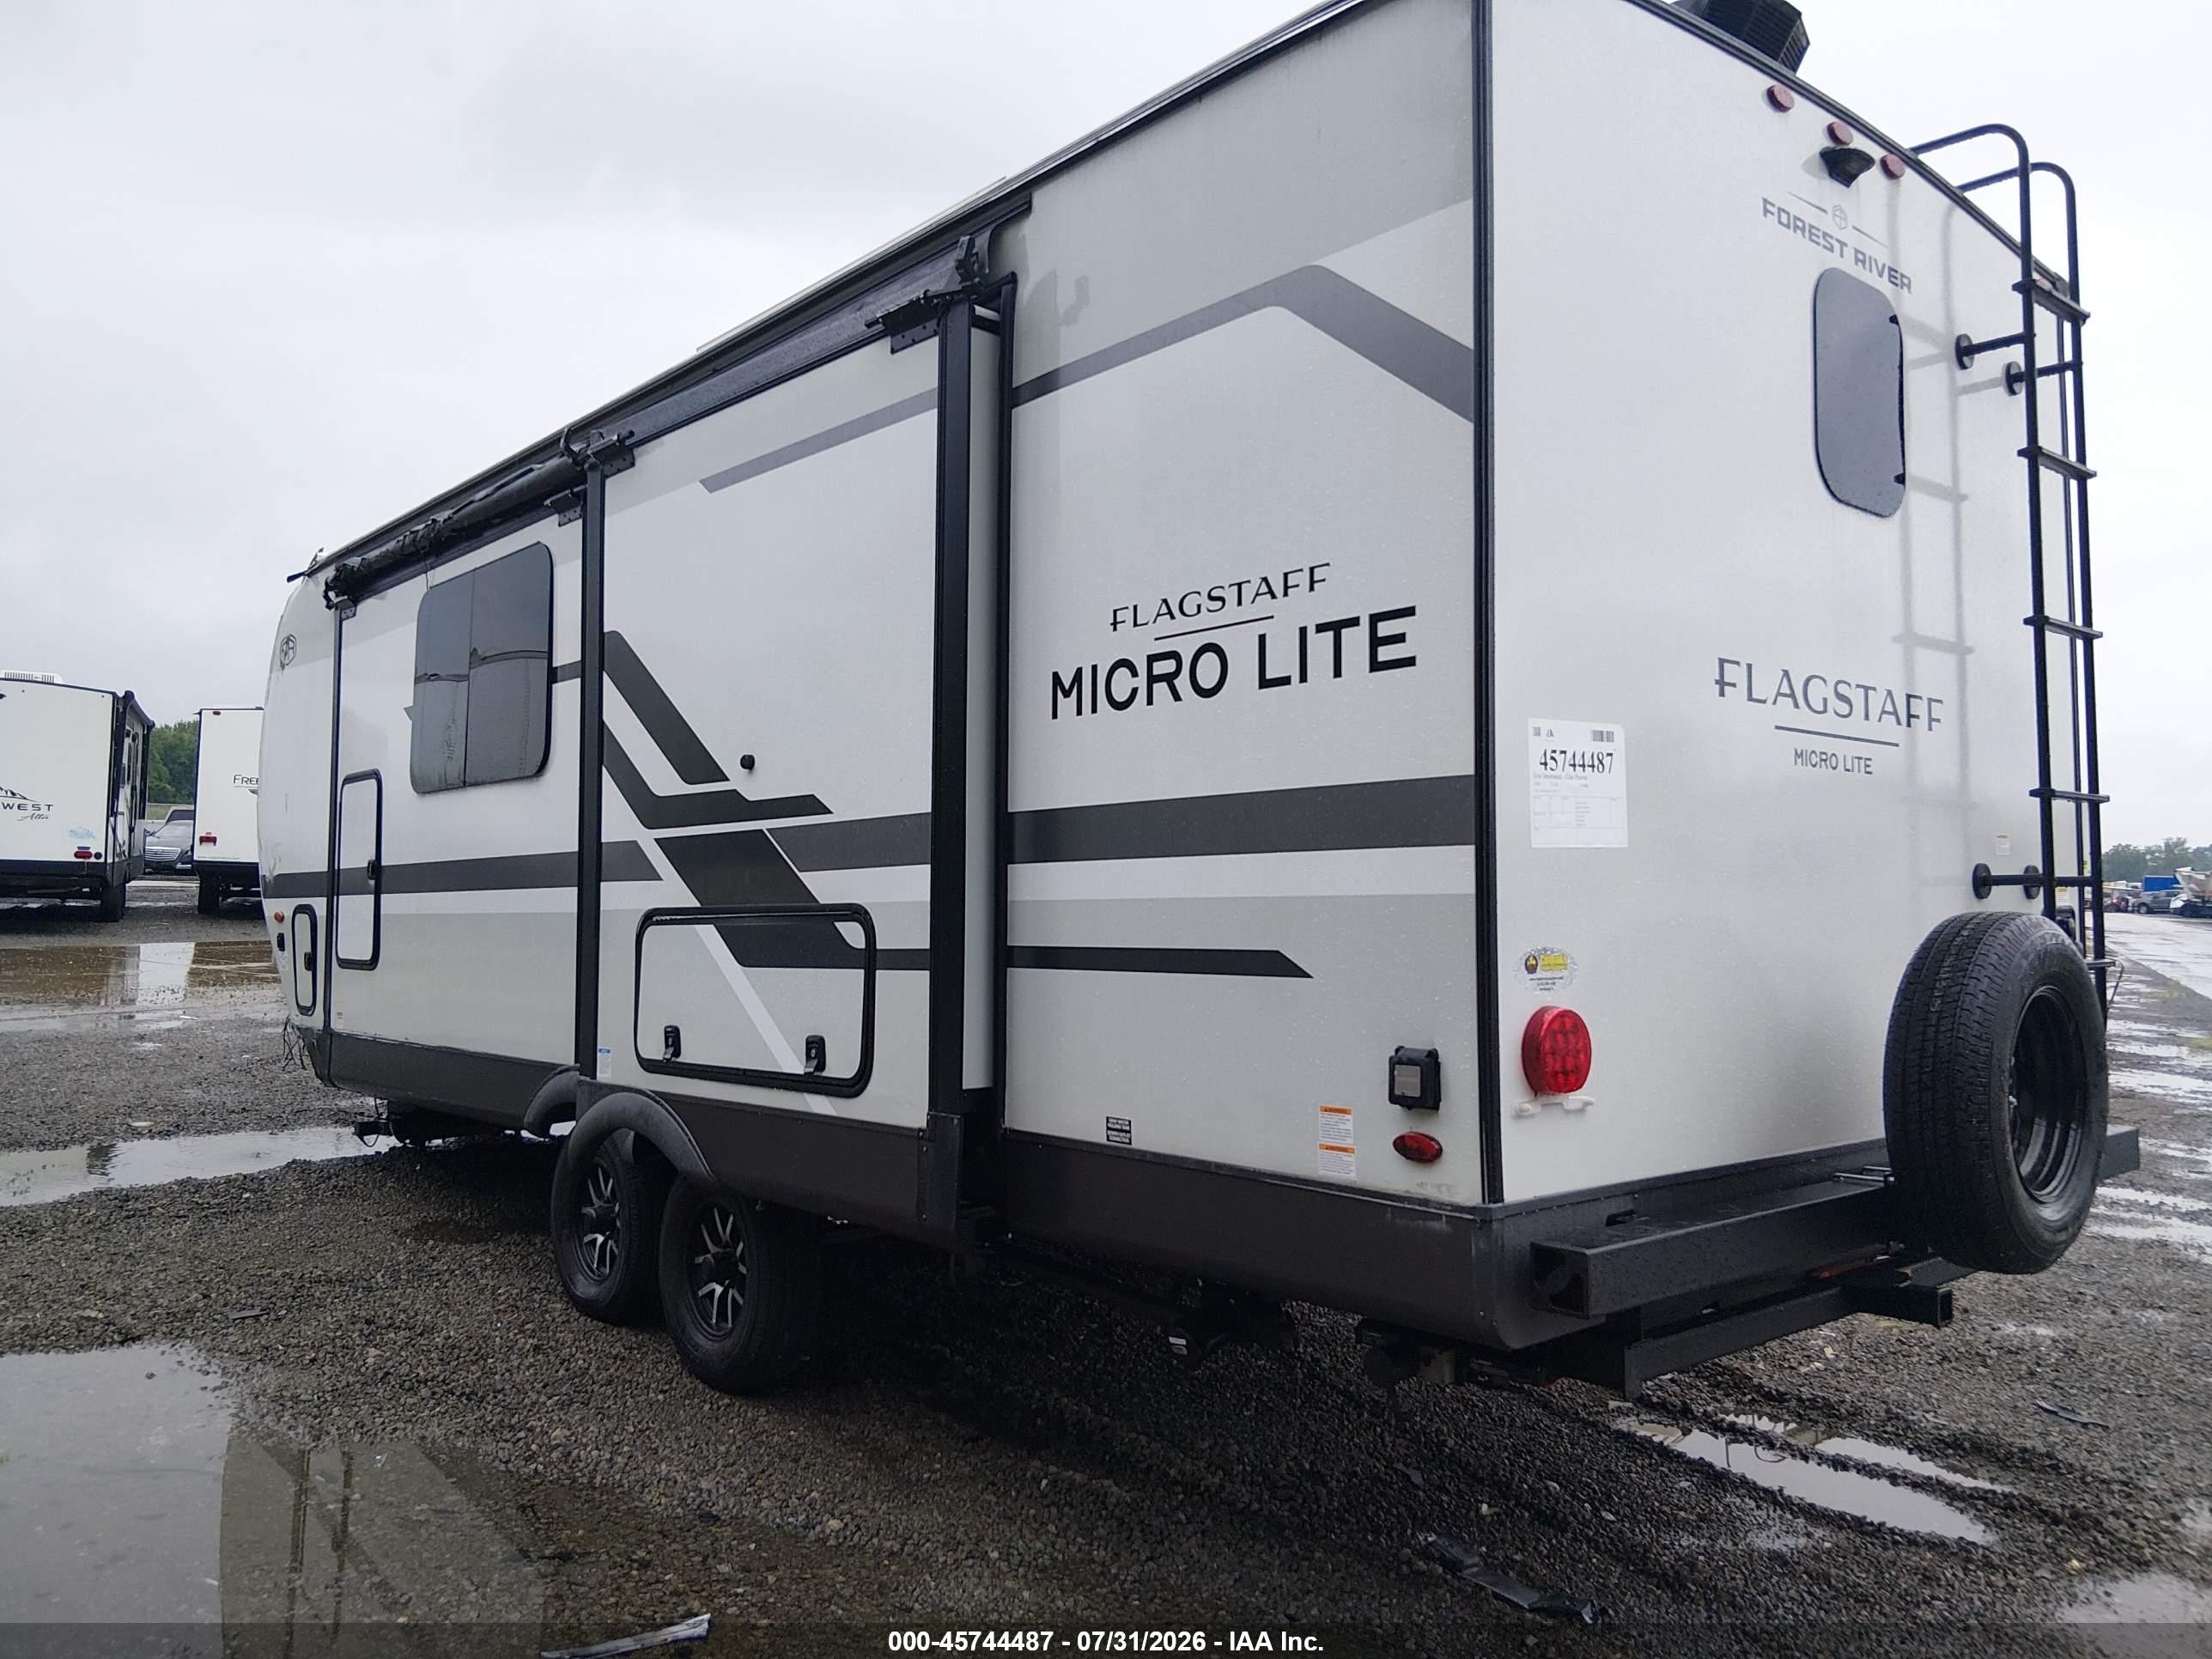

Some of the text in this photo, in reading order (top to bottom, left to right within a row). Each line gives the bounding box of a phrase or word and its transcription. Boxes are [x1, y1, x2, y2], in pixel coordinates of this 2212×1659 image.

[1761, 196, 1913, 295] FOREST RIVER
[1109, 562, 1331, 632] FLAGSTAFF
[1051, 605, 1417, 720] MICRO LITE
[1714, 656, 1944, 732] FLAGSTAFF
[1539, 748, 1615, 775] 45744487
[1793, 748, 1874, 775] MICRO LITE
[1, 802, 54, 812] WEST
